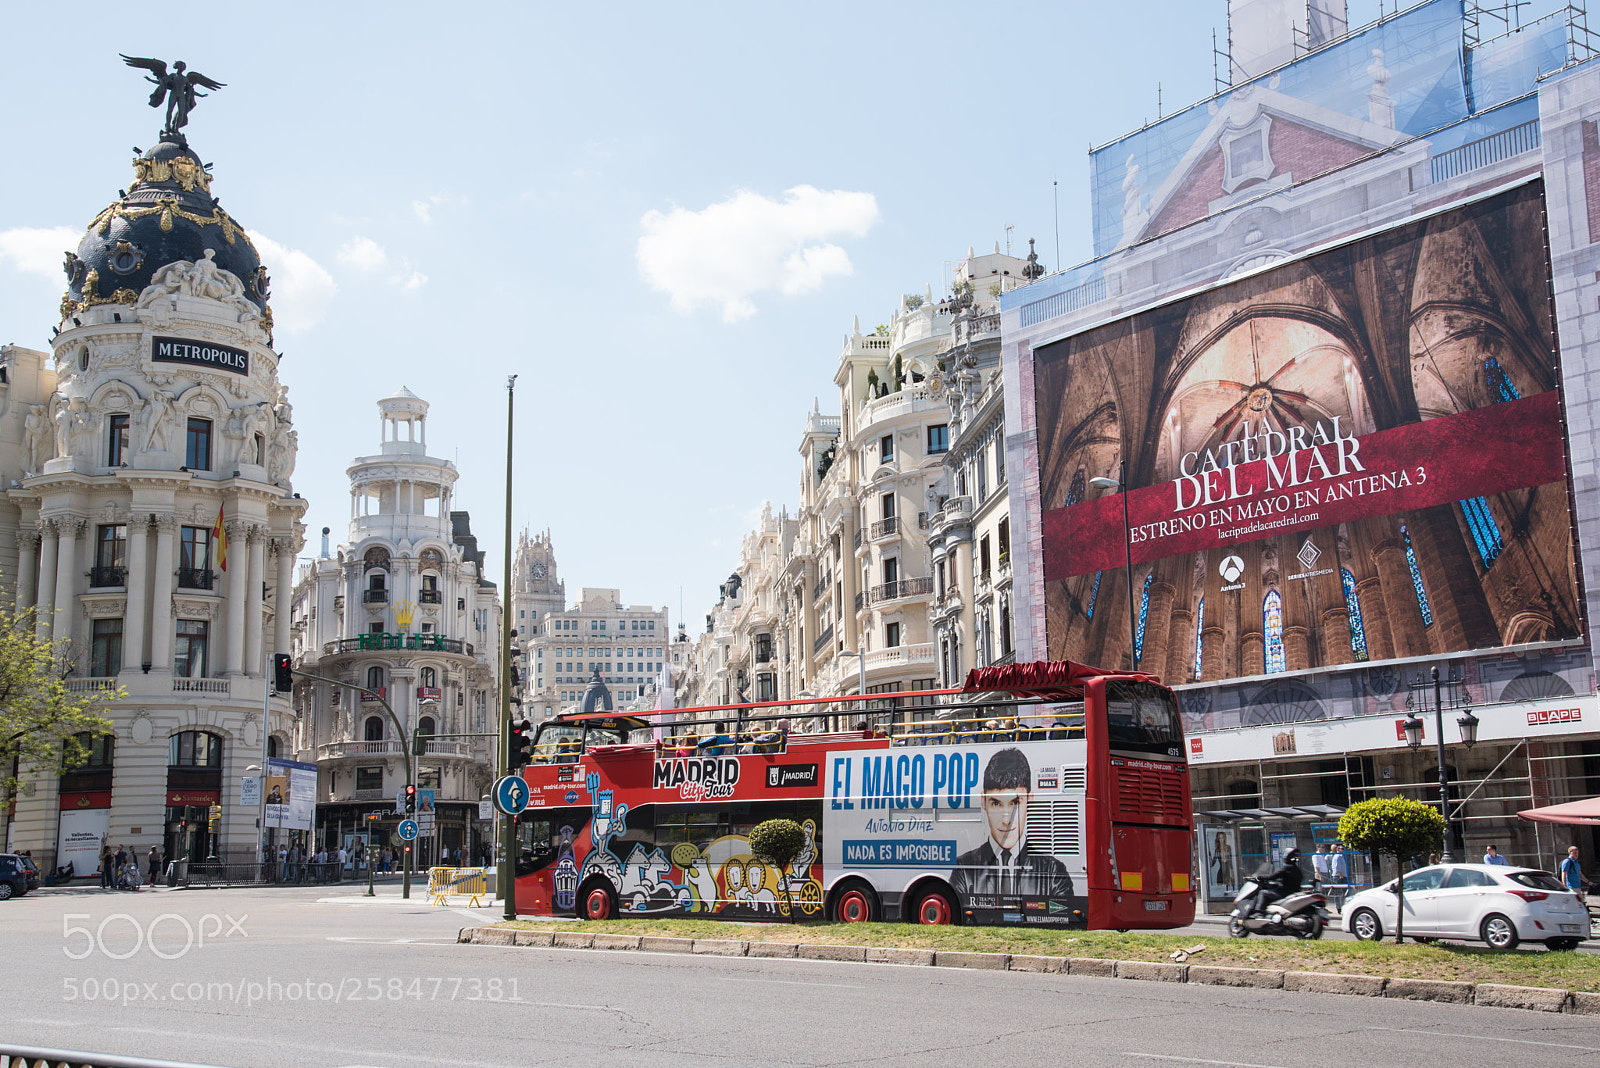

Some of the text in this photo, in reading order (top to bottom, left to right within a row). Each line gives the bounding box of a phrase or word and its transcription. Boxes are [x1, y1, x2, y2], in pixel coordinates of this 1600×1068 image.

[159, 342, 246, 369] METROPOLIS
[1242, 416, 1274, 441] LA
[1180, 415, 1353, 478] CATEDRAL
[1172, 437, 1366, 512] DEL MAR
[1130, 466, 1427, 544] ESTRENO EN MAYO EN ANTENA 3
[1217, 511, 1319, 540] lacriptadelacatedral.com
[1220, 584, 1241, 593] Antena
[357, 631, 448, 651] ROLEX
[1527, 708, 1581, 723] BLAPE
[1167, 747, 1179, 757] 4575
[653, 757, 740, 789] MADRID
[1127, 760, 1172, 771] madrid.city-tour.com
[680, 779, 734, 801] City Tour
[831, 752, 980, 811] EL MAGO POP
[847, 844, 952, 862] NADA ES IMPOSIBLE
